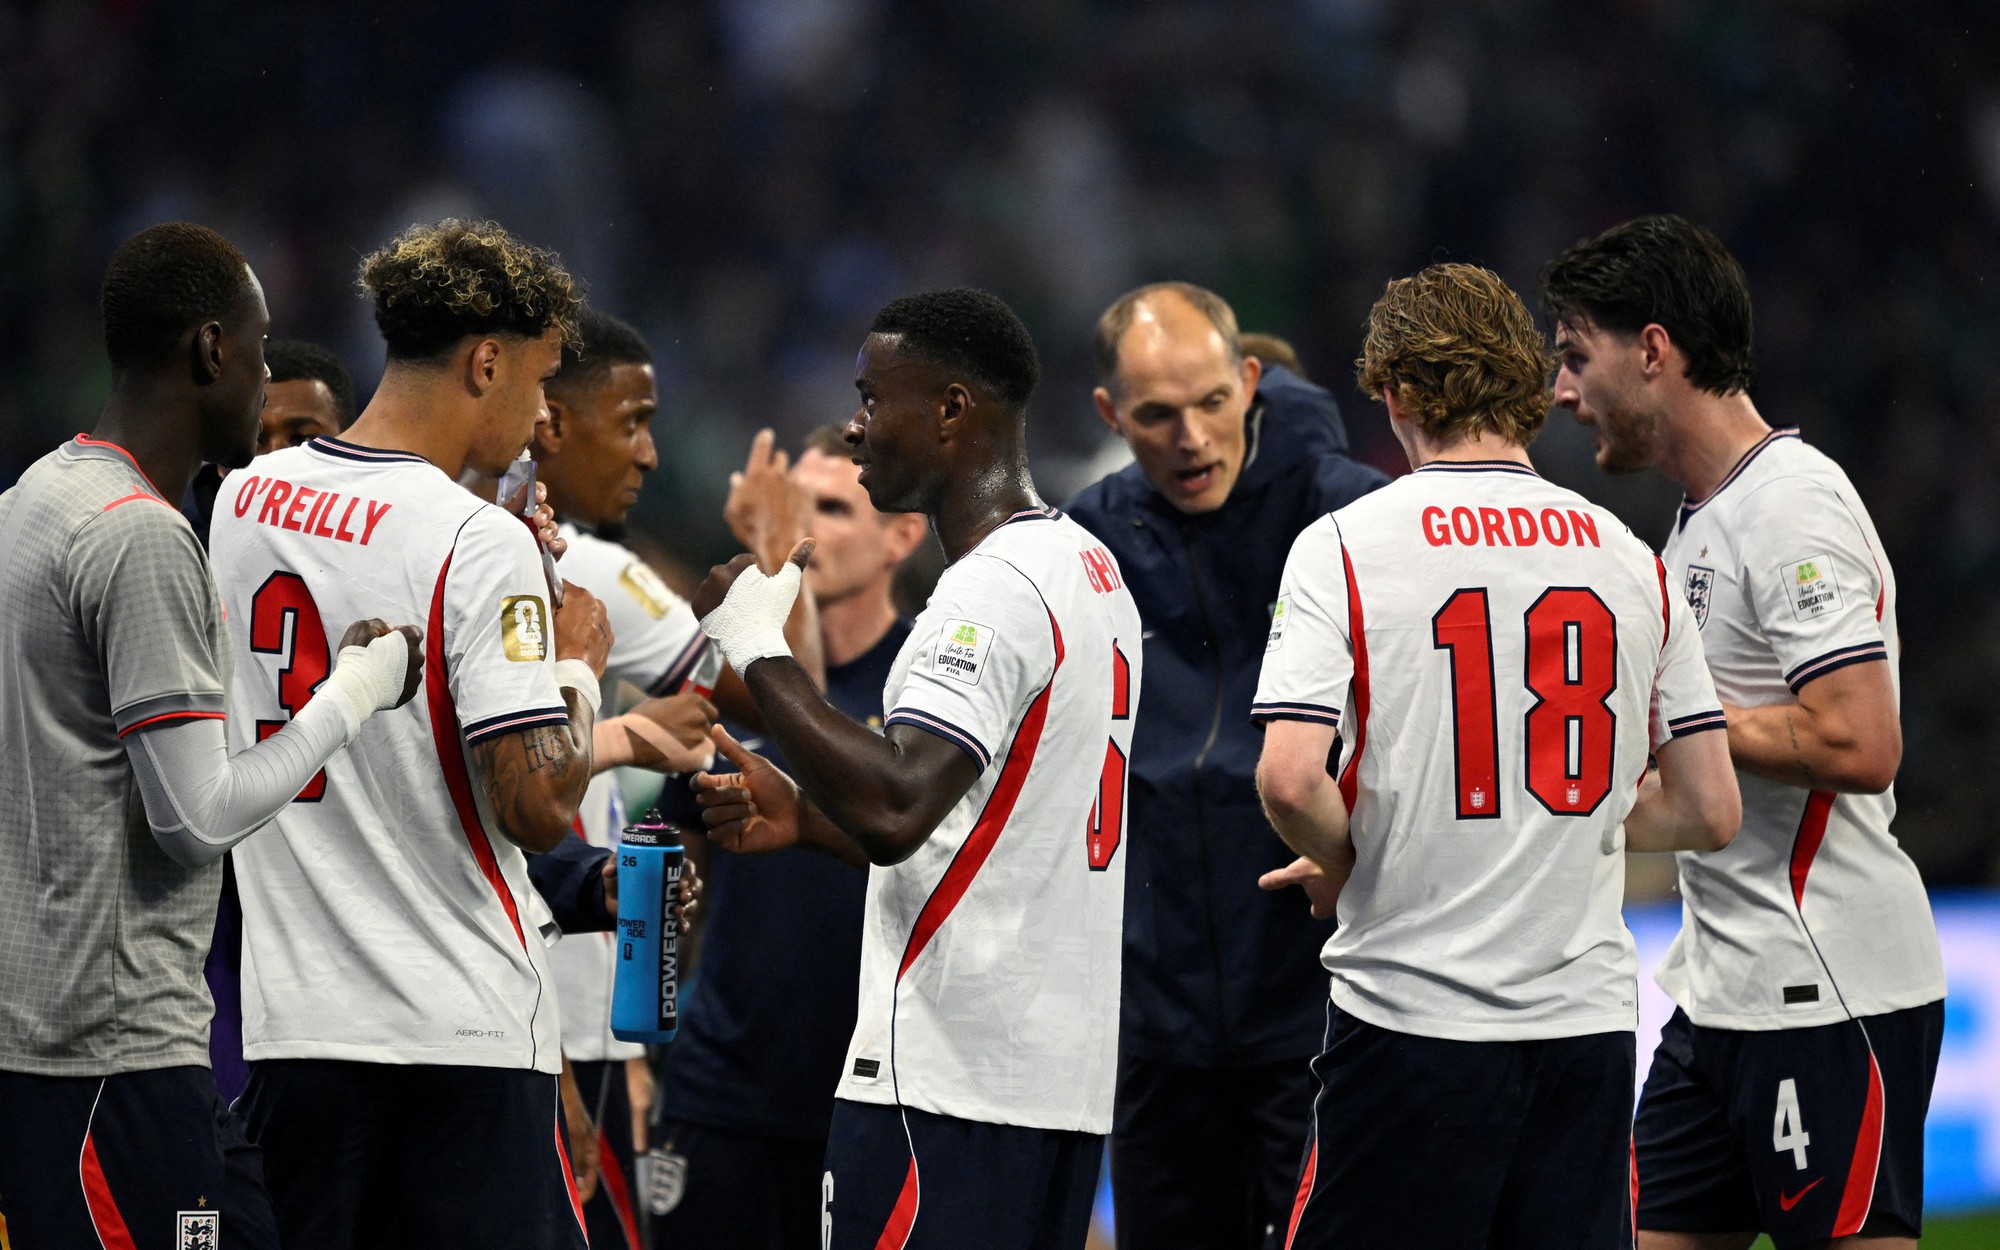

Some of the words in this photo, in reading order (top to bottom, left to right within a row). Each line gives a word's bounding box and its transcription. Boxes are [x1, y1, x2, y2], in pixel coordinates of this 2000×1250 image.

[234, 475, 393, 546] O'REILLY
[1421, 505, 1601, 548] GORDON
[1797, 591, 1835, 610] EDUCATION
[1811, 605, 1824, 613] FIFA
[945, 643, 963, 656] Unite
[964, 648, 975, 658] For
[938, 654, 977, 673] EDUCATION
[946, 667, 960, 676] FIFA
[249, 570, 331, 802] 3
[1431, 586, 1618, 821] 18
[622, 855, 637, 867] 26
[455, 1029, 505, 1038] AERO-FIT
[1773, 1078, 1810, 1171] 4
